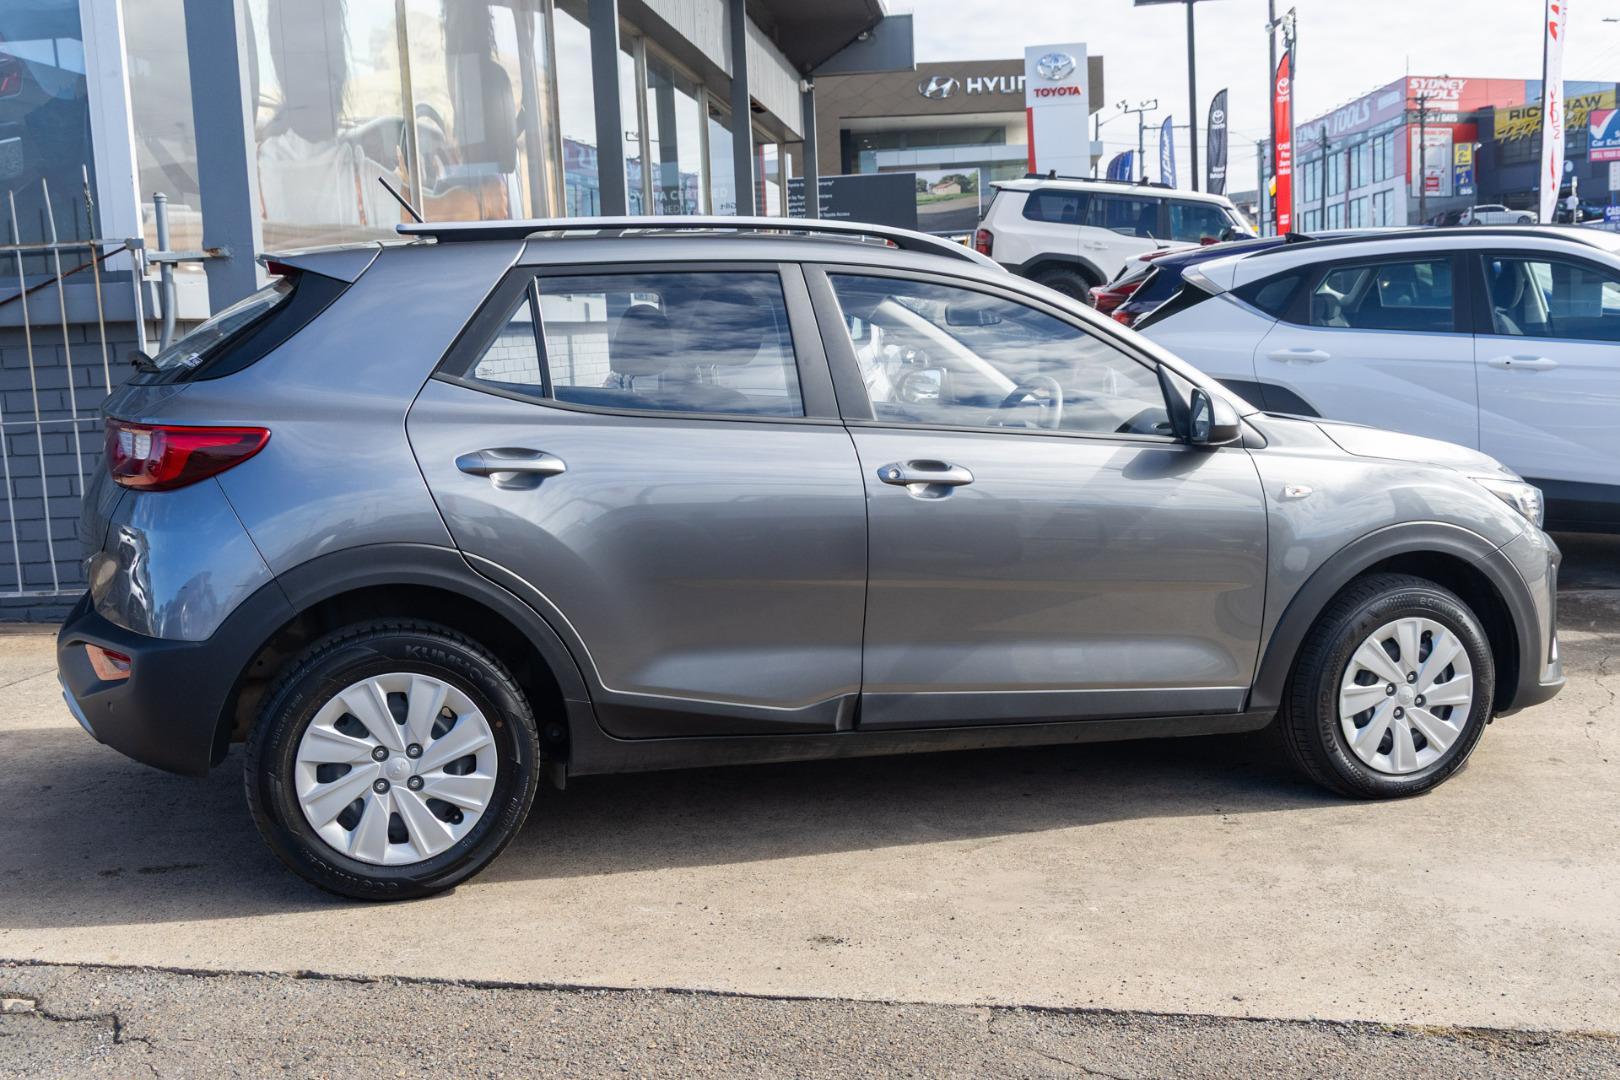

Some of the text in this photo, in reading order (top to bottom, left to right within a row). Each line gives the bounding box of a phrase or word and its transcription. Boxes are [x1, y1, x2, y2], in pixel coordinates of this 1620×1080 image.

[1410, 78, 1467, 90] SYDNEY
[1033, 86, 1081, 98] TOYOTA
[1415, 89, 1461, 100] TOOLS
[1332, 98, 1371, 134] TOOLS
[404, 644, 483, 680] KUMHO
